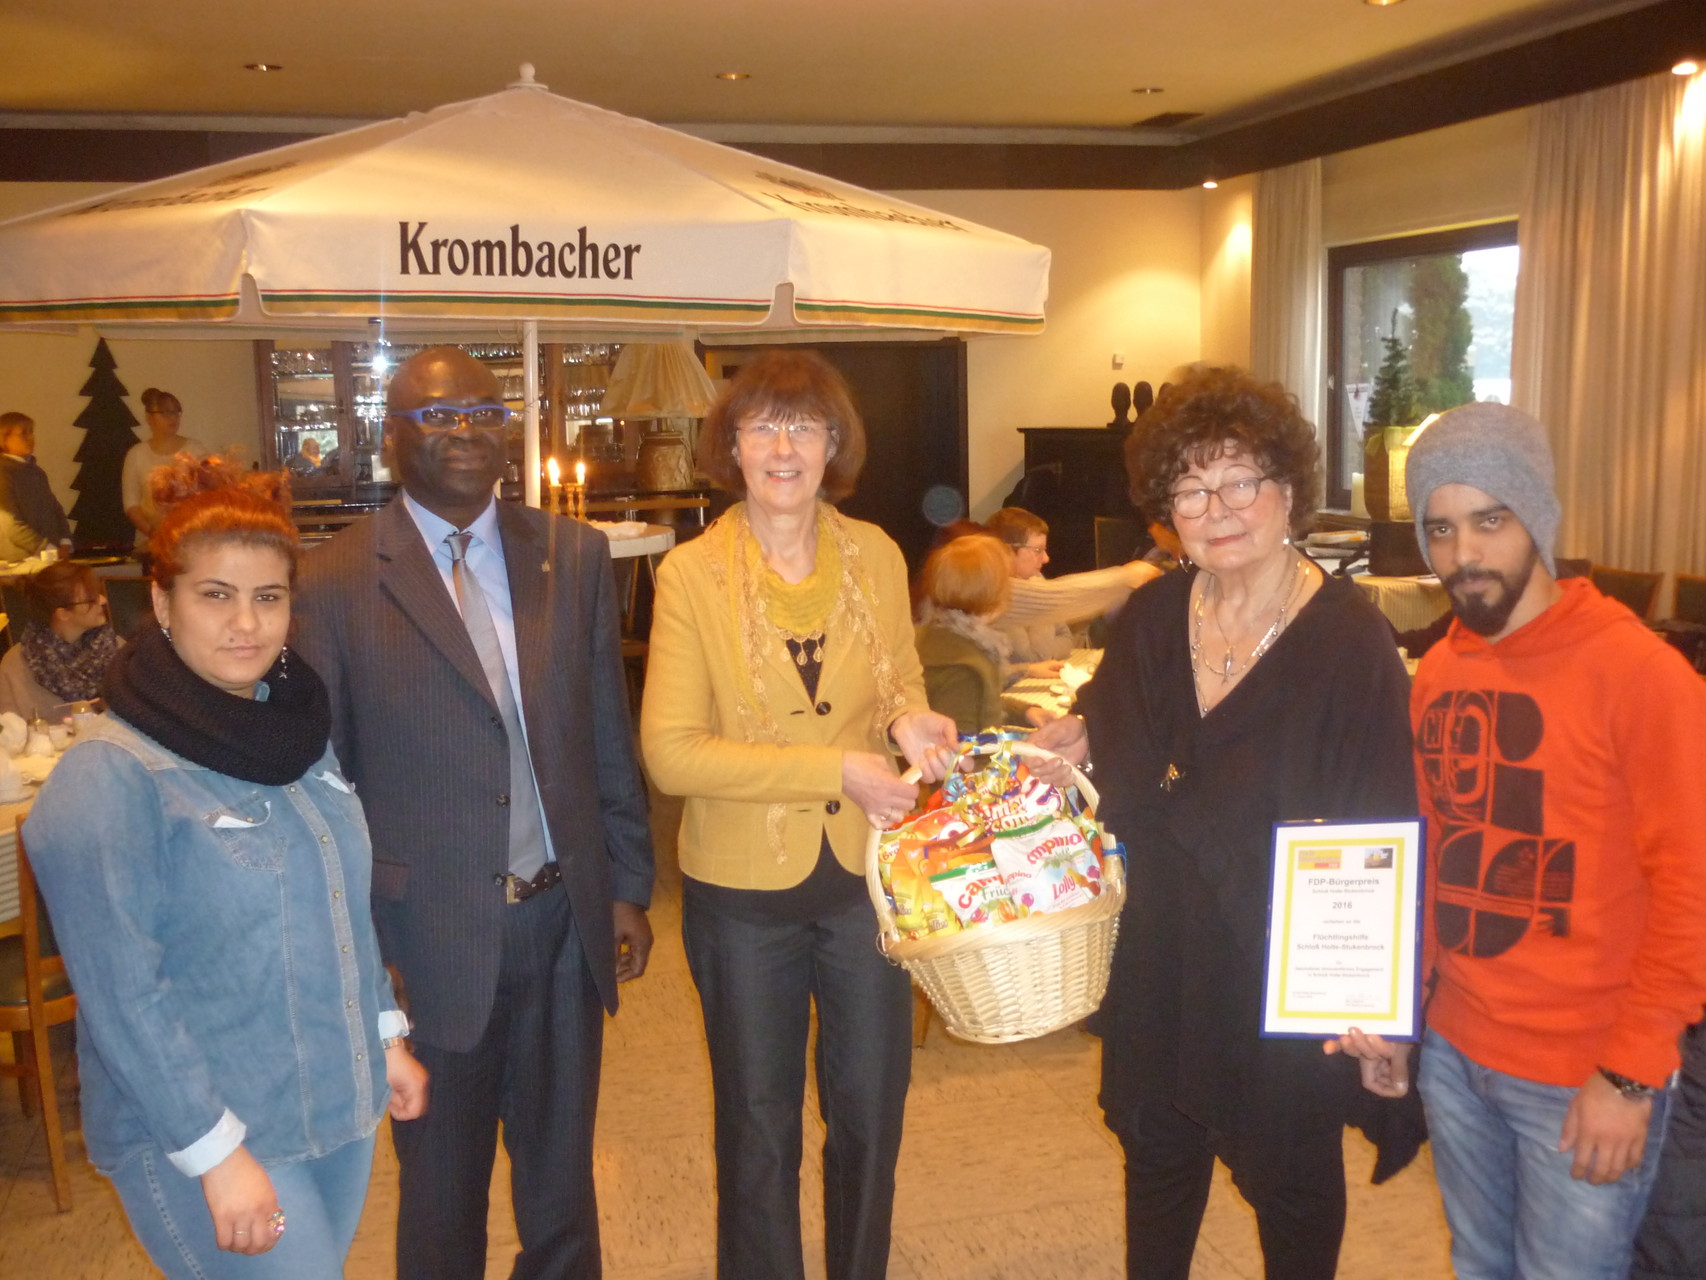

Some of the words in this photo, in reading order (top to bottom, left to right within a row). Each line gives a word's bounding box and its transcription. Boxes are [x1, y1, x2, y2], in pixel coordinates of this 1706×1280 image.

[399, 221, 642, 280] Krombacher
[1052, 874, 1076, 900] Lolly
[1308, 878, 1380, 887] FDP-Bürgerpreis
[1313, 933, 1369, 942] Flüchtlingshilfe
[1297, 943, 1320, 951] Schloß
[1322, 943, 1385, 951] Holte-Stukenbrock
